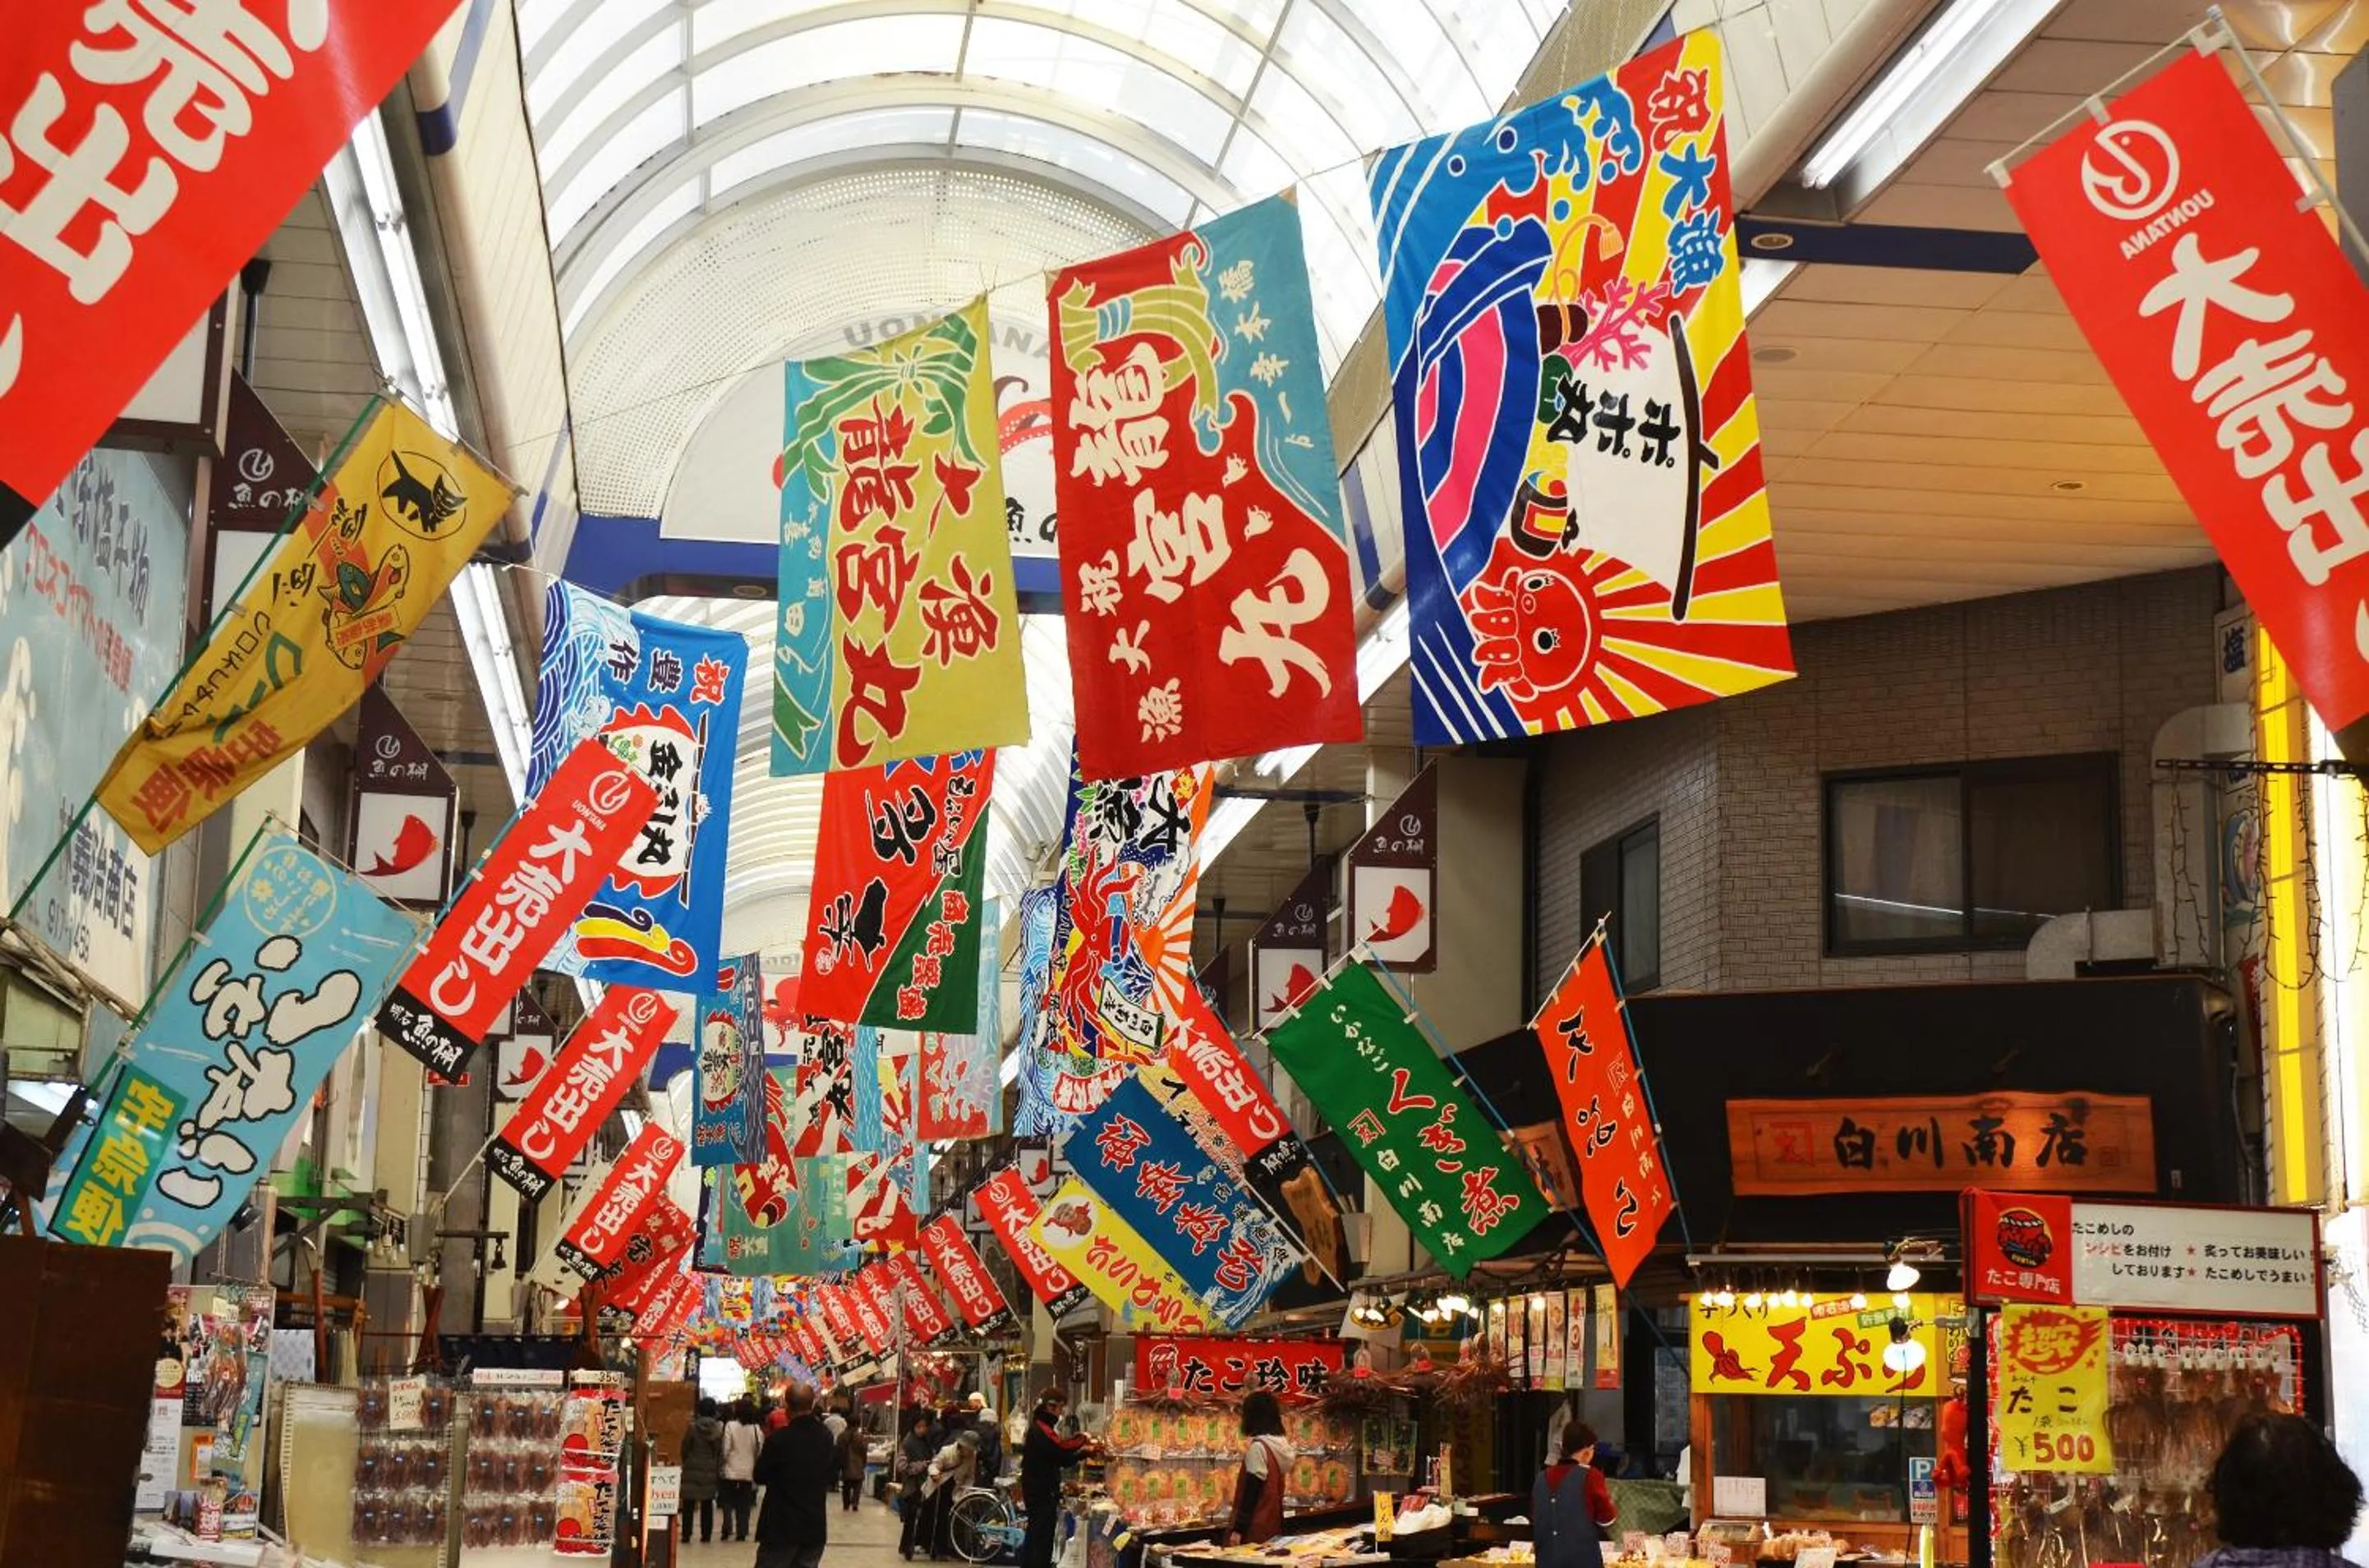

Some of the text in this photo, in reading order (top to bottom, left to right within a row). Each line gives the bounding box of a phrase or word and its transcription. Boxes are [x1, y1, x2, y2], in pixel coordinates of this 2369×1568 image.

[1647, 67, 1725, 294] 祝大漁
[834, 394, 925, 770] 龍宮丸
[919, 452, 1000, 670] 大漁
[1079, 549, 1182, 743] 祝大漁
[429, 818, 594, 1017] 大売出し
[1330, 1004, 1388, 1074] いかなご
[519, 1026, 635, 1161] 大売出し
[1387, 1068, 1520, 1235] くぎ煮
[1833, 1112, 2089, 1170] 白川南店
[577, 1161, 660, 1255] 大売出し
[1376, 1147, 1466, 1256] 白川南店
[2072, 1222, 2135, 1236] たこめしの
[1986, 1269, 2062, 1295] たこ専門店
[2112, 1263, 2186, 1278] しております
[1181, 1355, 1332, 1394] たこ珍味
[2007, 1385, 2078, 1415] たこ
[1915, 1459, 1930, 1478] P
